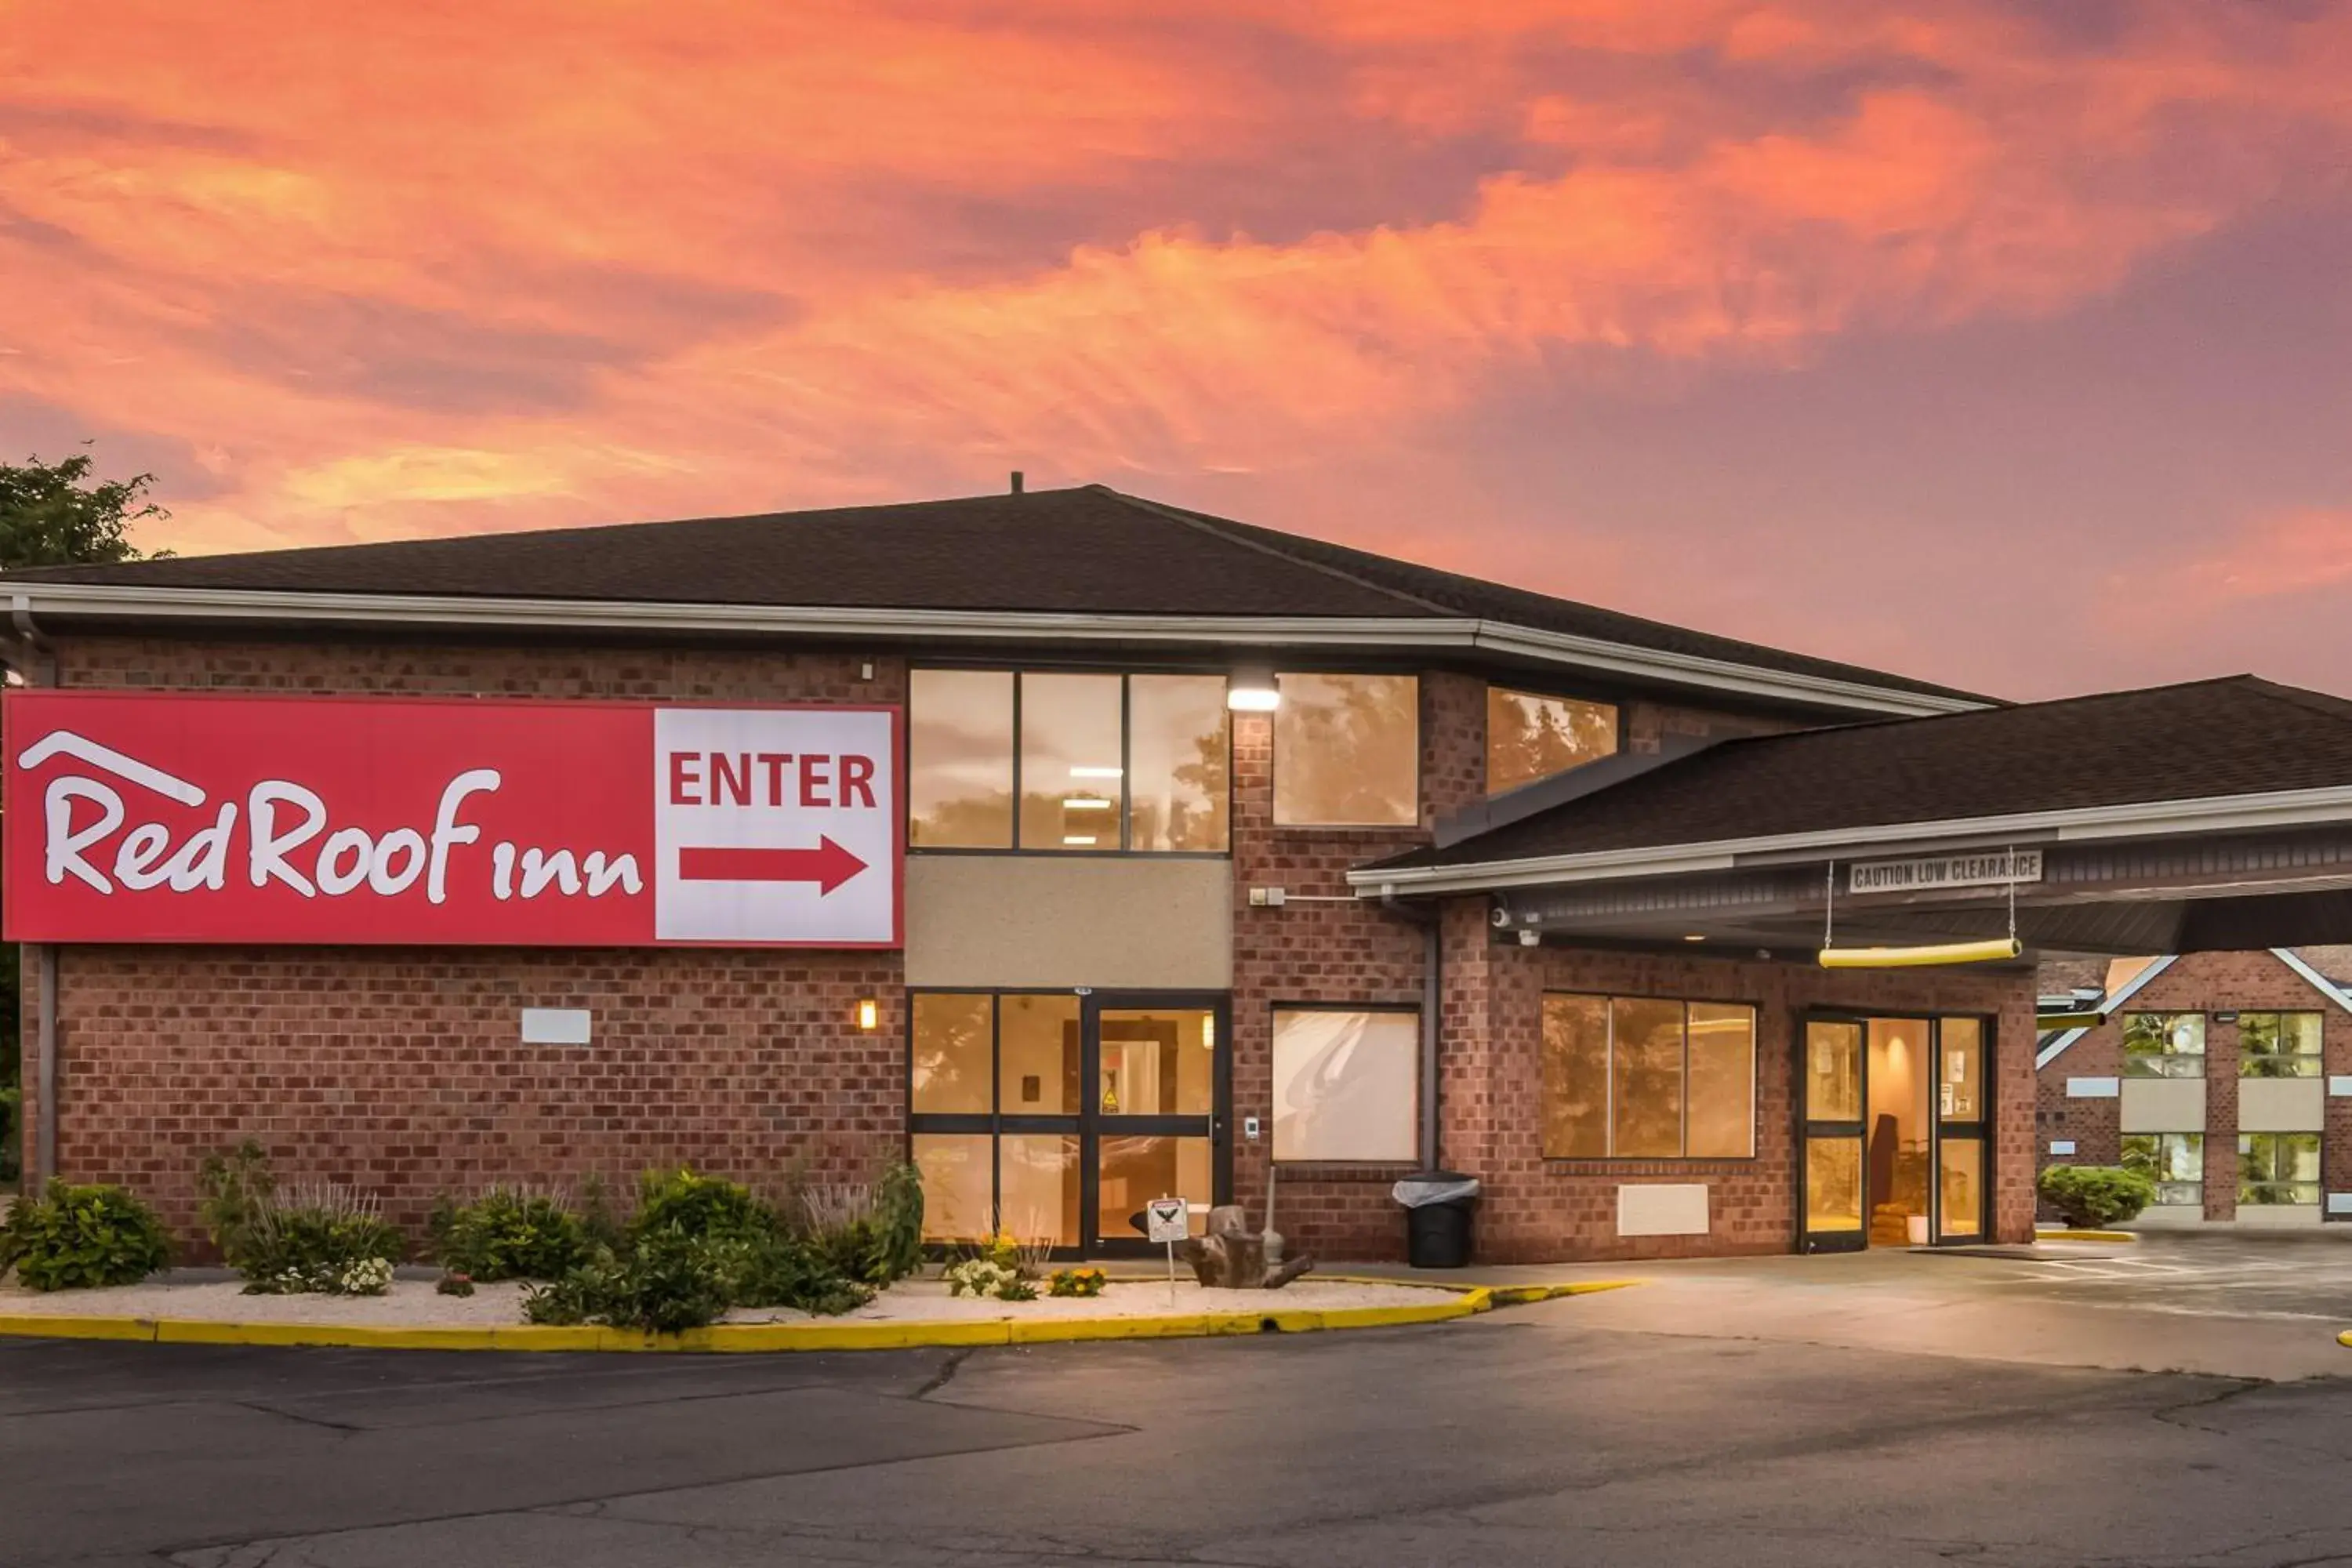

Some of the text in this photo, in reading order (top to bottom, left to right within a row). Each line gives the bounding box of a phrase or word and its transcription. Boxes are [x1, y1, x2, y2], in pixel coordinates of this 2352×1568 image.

[670, 752, 877, 808] ENTER
[45, 775, 238, 895] Red
[248, 769, 502, 904] Roof
[1854, 864, 1913, 888] CAUTION
[1918, 860, 1947, 884] LOW
